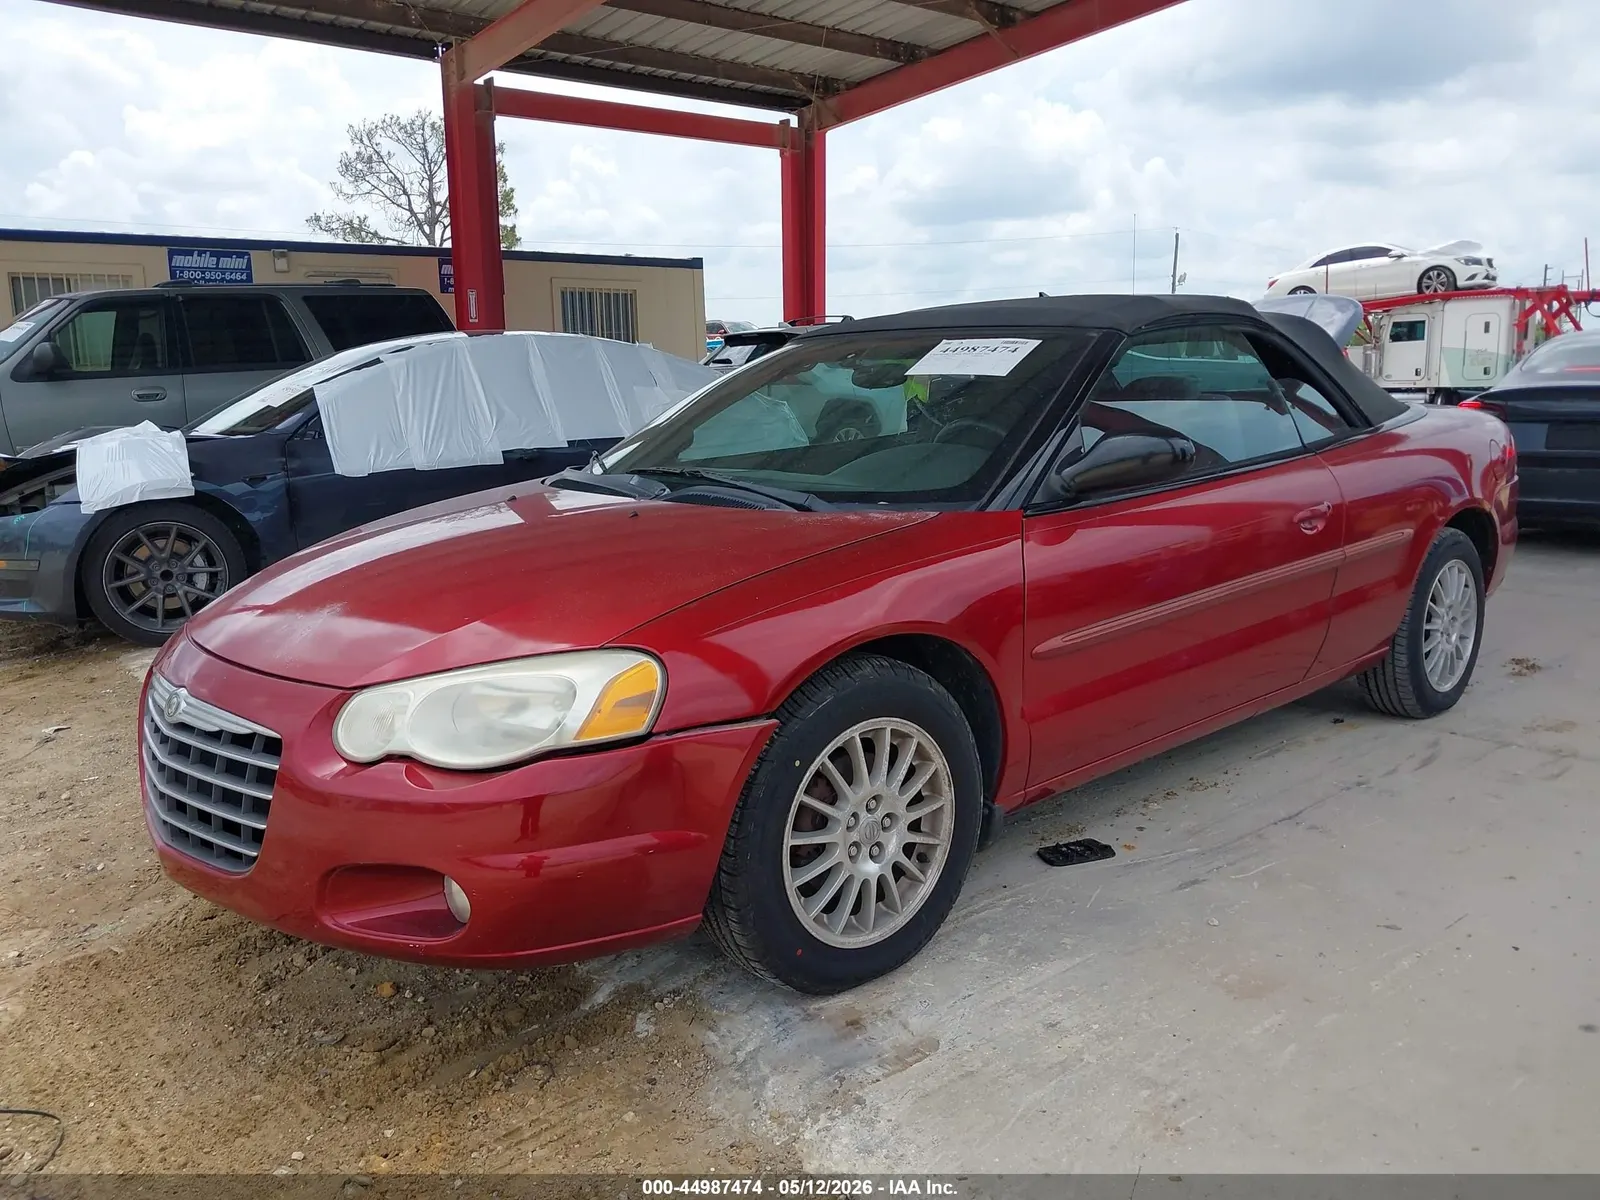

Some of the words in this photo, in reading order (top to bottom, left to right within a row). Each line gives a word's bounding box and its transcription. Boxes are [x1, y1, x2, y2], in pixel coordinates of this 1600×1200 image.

[171, 251, 217, 268] mobile
[218, 255, 249, 269] mini
[176, 270, 247, 280] 1-800-950-6464
[939, 345, 1020, 353] 44987474
